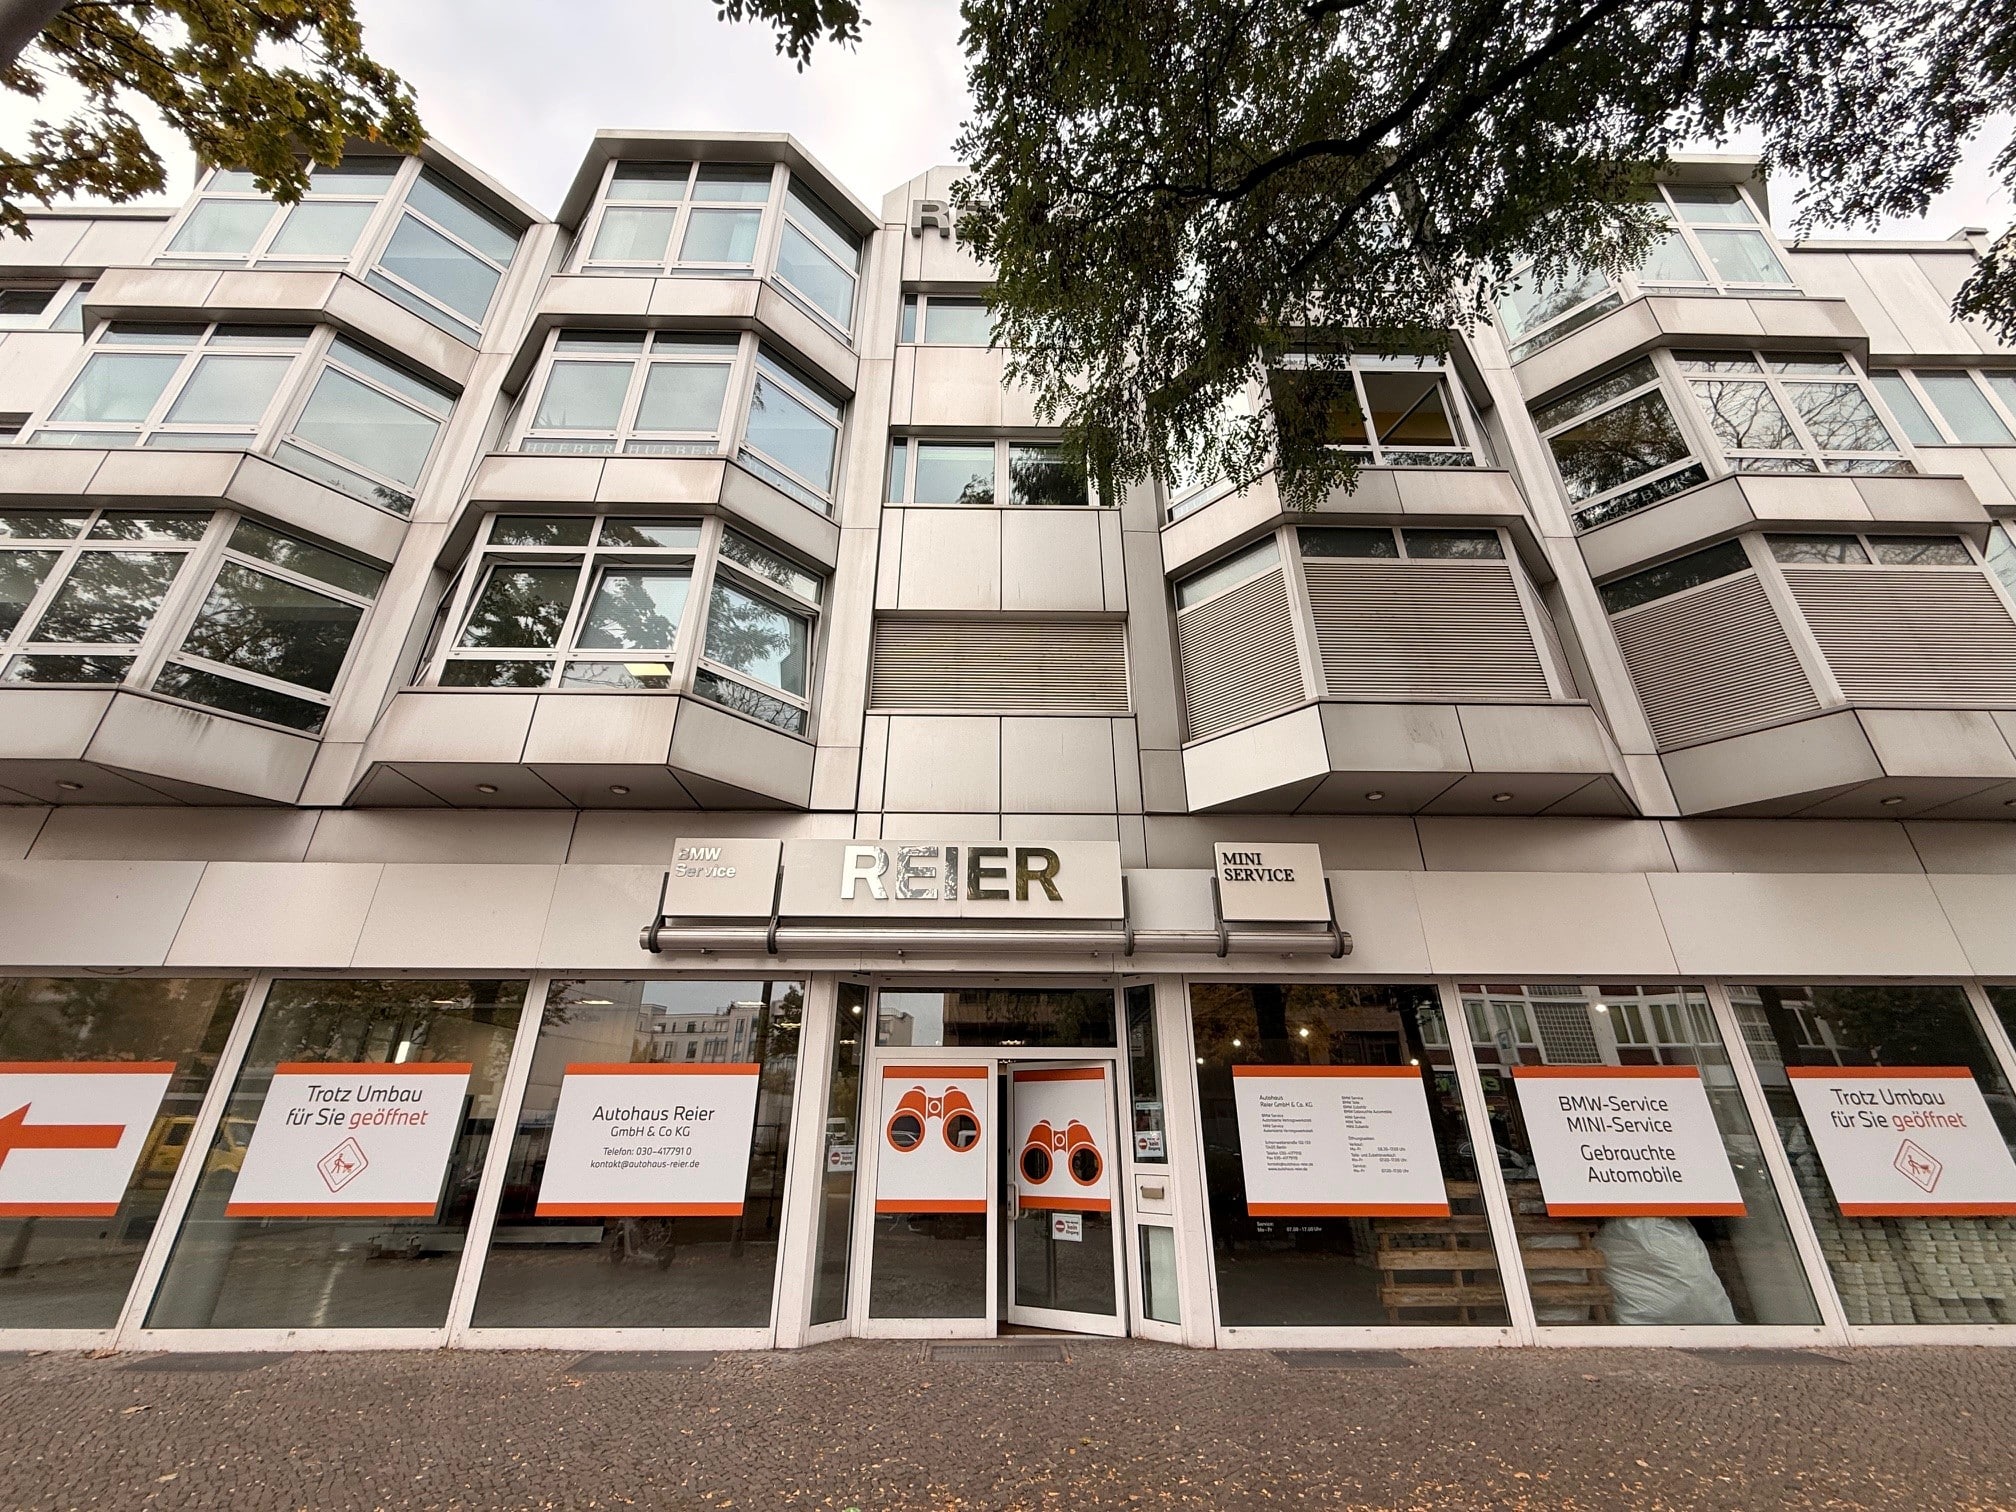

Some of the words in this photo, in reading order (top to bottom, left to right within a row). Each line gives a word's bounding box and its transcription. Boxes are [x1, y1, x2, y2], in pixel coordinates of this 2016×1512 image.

[678, 847, 721, 861] BMW
[1222, 852, 1262, 866] MINI
[675, 863, 736, 878] Service
[841, 845, 1063, 901] REIER
[1224, 868, 1295, 882] SERVICE
[308, 1085, 352, 1102] Trotz
[356, 1085, 422, 1102] Umbau
[1830, 1088, 1879, 1105] Trotz
[1879, 1088, 1945, 1105] Umbau
[1558, 1095, 1669, 1111] BMW-Service
[286, 1108, 313, 1125] für
[315, 1108, 345, 1125] Sie
[348, 1108, 429, 1129] geöffnet
[592, 1106, 669, 1121] Autohaus
[673, 1106, 715, 1121] Reier
[1830, 1111, 1855, 1128] für
[1858, 1111, 1889, 1128] Sie
[1892, 1111, 1967, 1132] geöffnet
[610, 1126, 645, 1137] GmbH
[646, 1126, 655, 1137] &
[658, 1126, 672, 1137] Co
[675, 1126, 690, 1137] KG
[1566, 1116, 1673, 1132] MINI-Service
[603, 1147, 634, 1156] Telefon:
[1580, 1144, 1676, 1161] Gebrauchte
[590, 1160, 700, 1169] kontakt@autohaus-reier.de
[1588, 1166, 1683, 1183] Automobile
